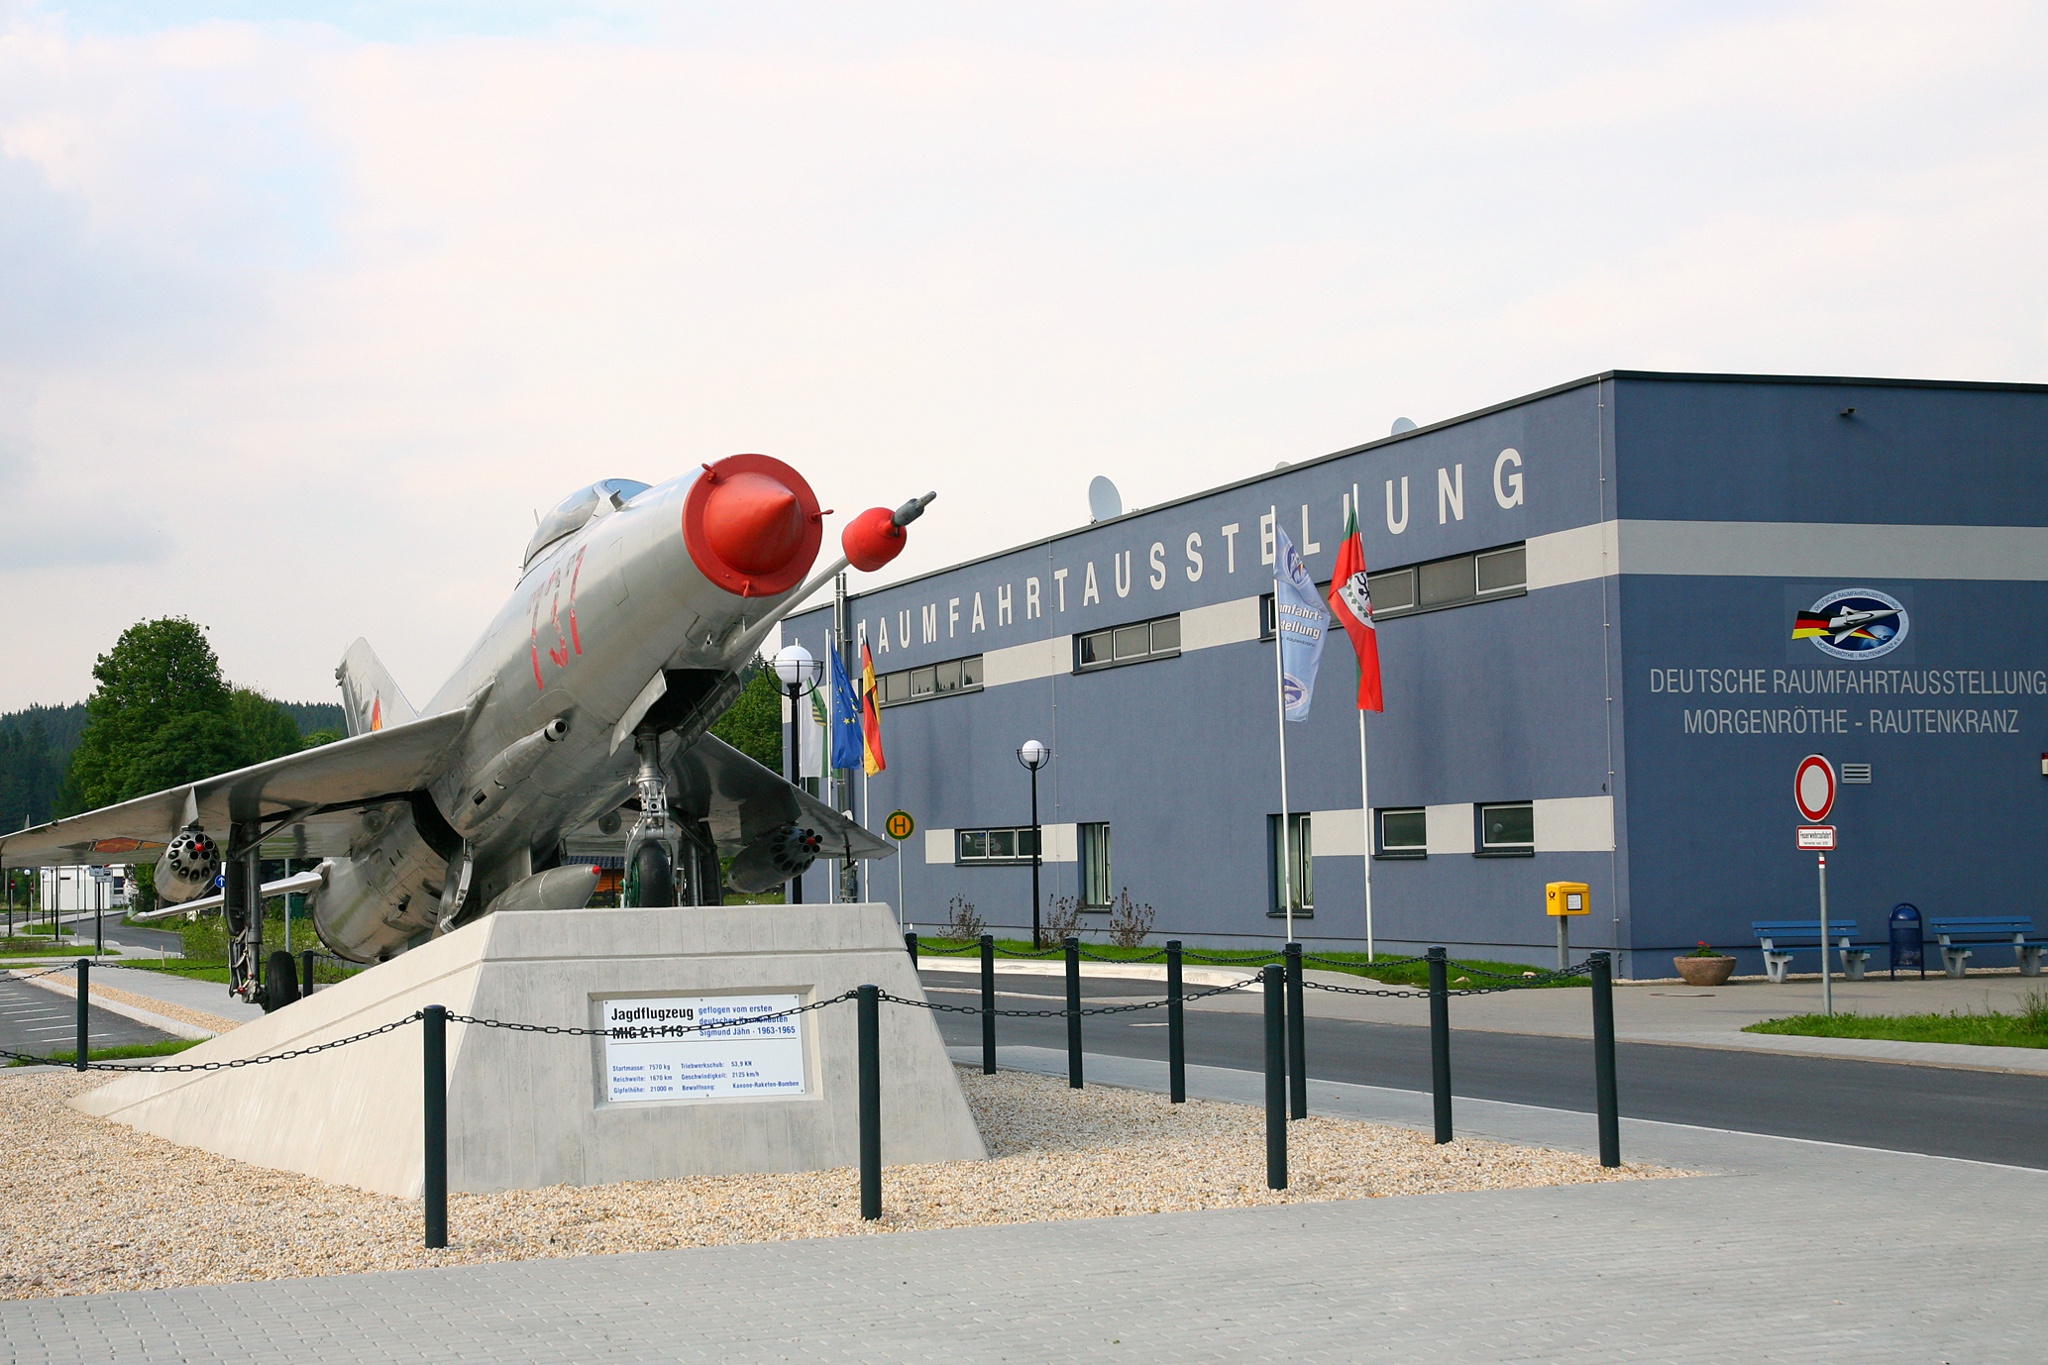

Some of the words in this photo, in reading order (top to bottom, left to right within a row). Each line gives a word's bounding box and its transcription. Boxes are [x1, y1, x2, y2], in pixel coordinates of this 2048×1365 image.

[1650, 668, 1767, 694] DEUTSCHE
[1773, 669, 2047, 695] RAUMFAHRTAUSSTELLUNG
[1684, 705, 1848, 734] MORGENRÖTHE
[1870, 709, 2019, 734] RAUTENKRANZ
[894, 817, 906, 834] H
[611, 1007, 694, 1022] Jagdflugzeug
[698, 1006, 730, 1015] geflogen
[700, 1028, 731, 1037] Sigmund
[733, 1027, 751, 1035] Jähn
[757, 1026, 796, 1035] 1963-1965
